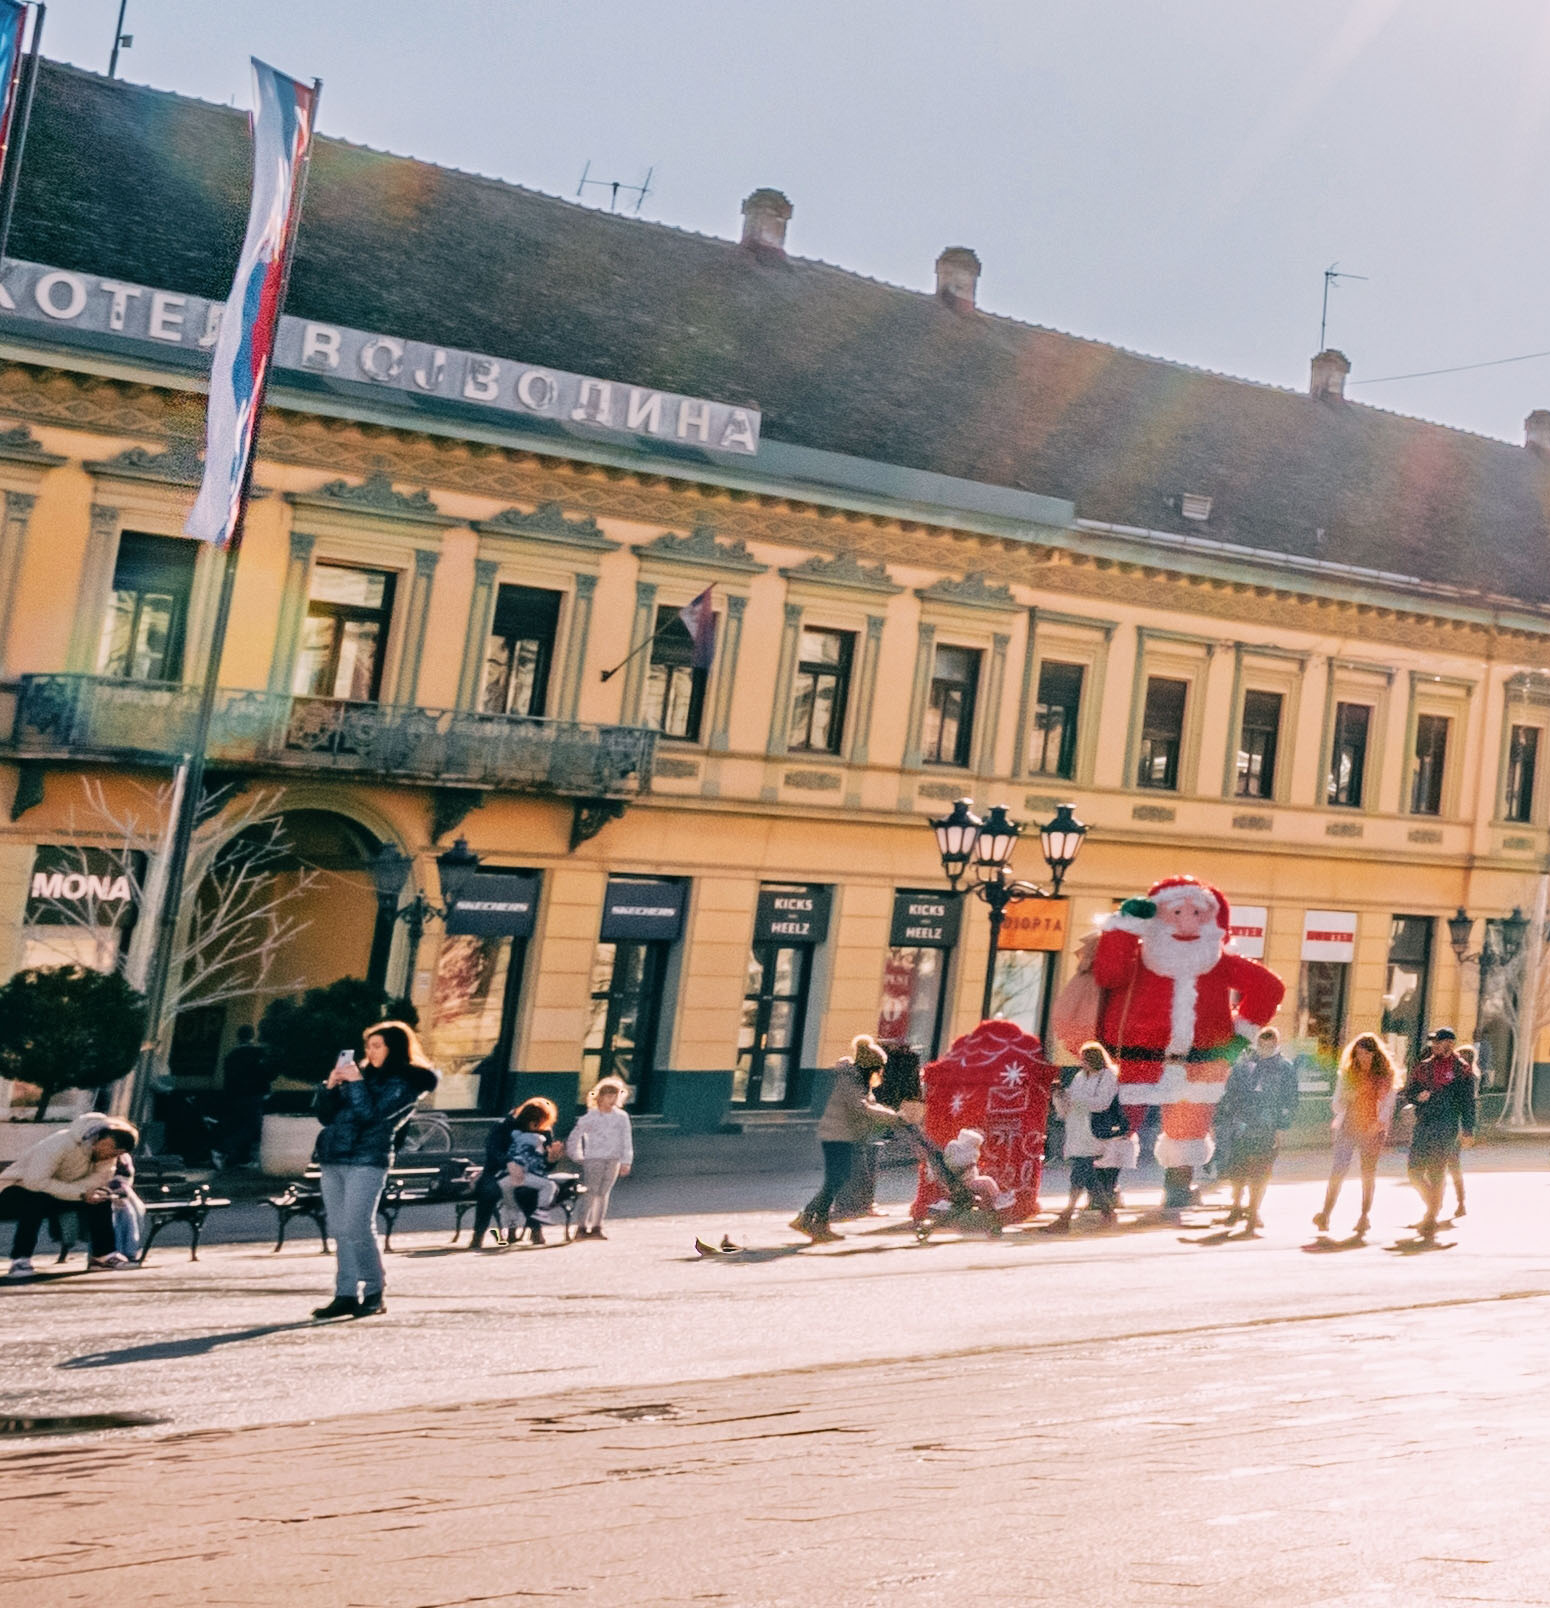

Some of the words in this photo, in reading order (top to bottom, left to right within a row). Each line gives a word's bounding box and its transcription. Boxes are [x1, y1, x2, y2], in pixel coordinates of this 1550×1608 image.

[32, 872, 131, 901] MONA
[774, 898, 813, 911] KICKS
[909, 904, 945, 917] KICKS
[771, 922, 810, 935] HEELZ
[906, 927, 942, 940] HEELZ
